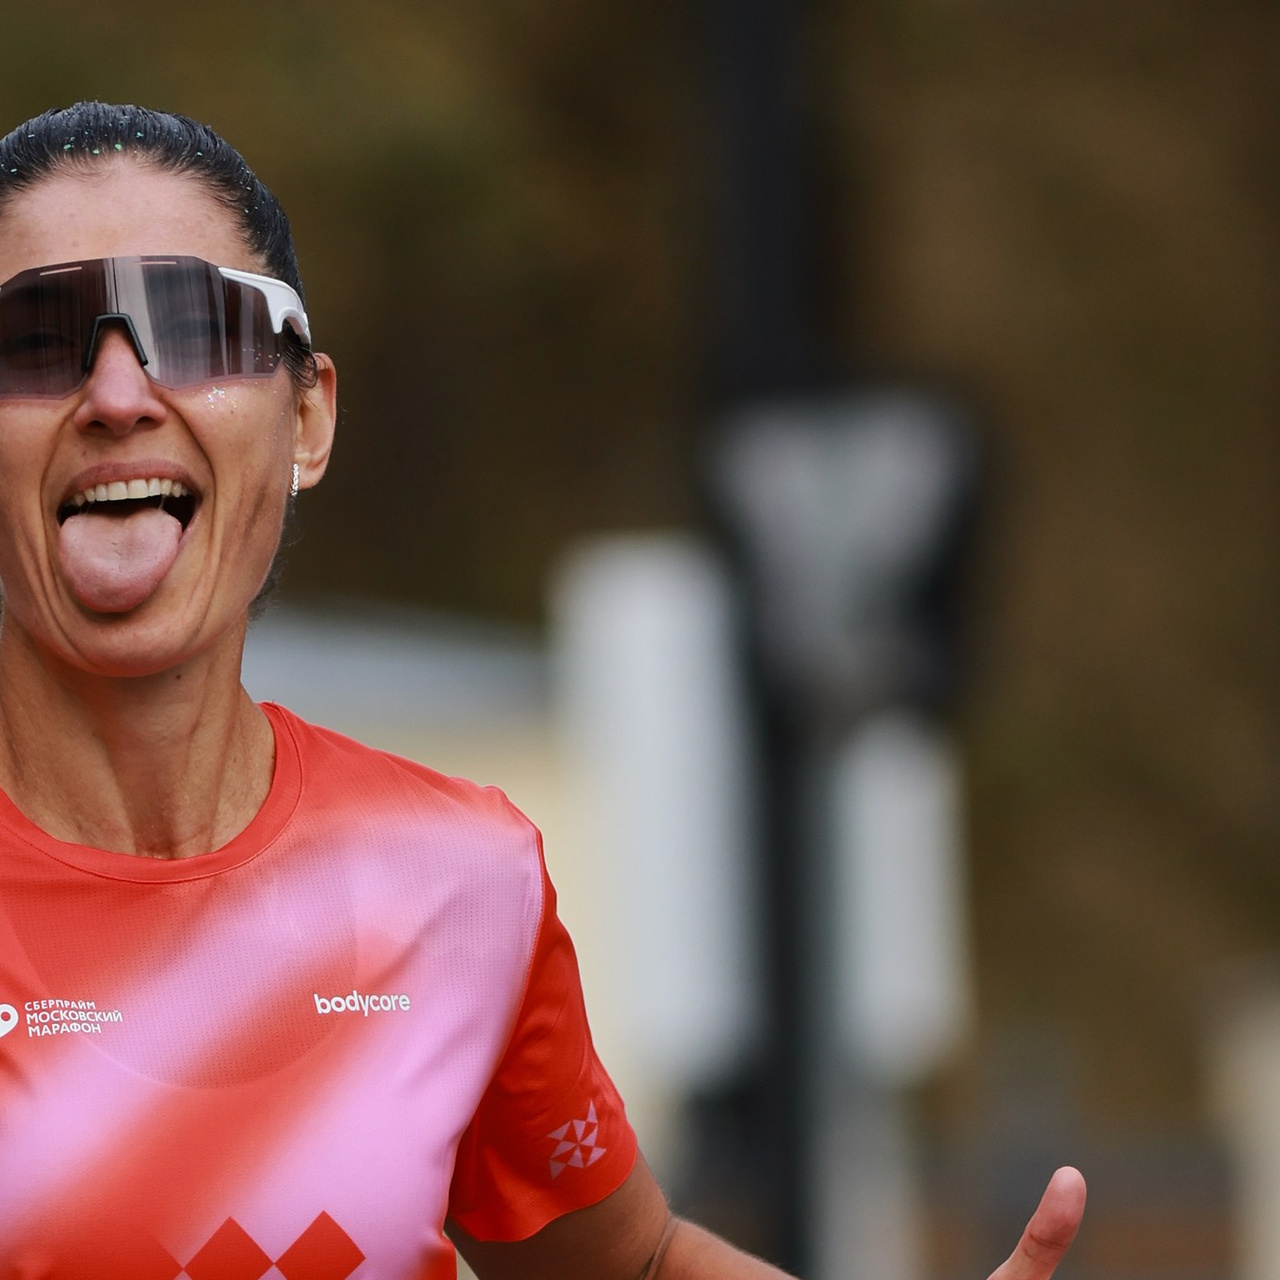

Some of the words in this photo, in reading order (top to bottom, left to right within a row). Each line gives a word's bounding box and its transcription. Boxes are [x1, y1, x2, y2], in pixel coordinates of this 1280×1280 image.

[24, 999, 97, 1012] СБЕРПРАЙМ
[313, 989, 411, 1017] bodycore
[25, 1009, 124, 1025] МОСКОВСКИЙ
[27, 1022, 102, 1038] МАРАФОН
